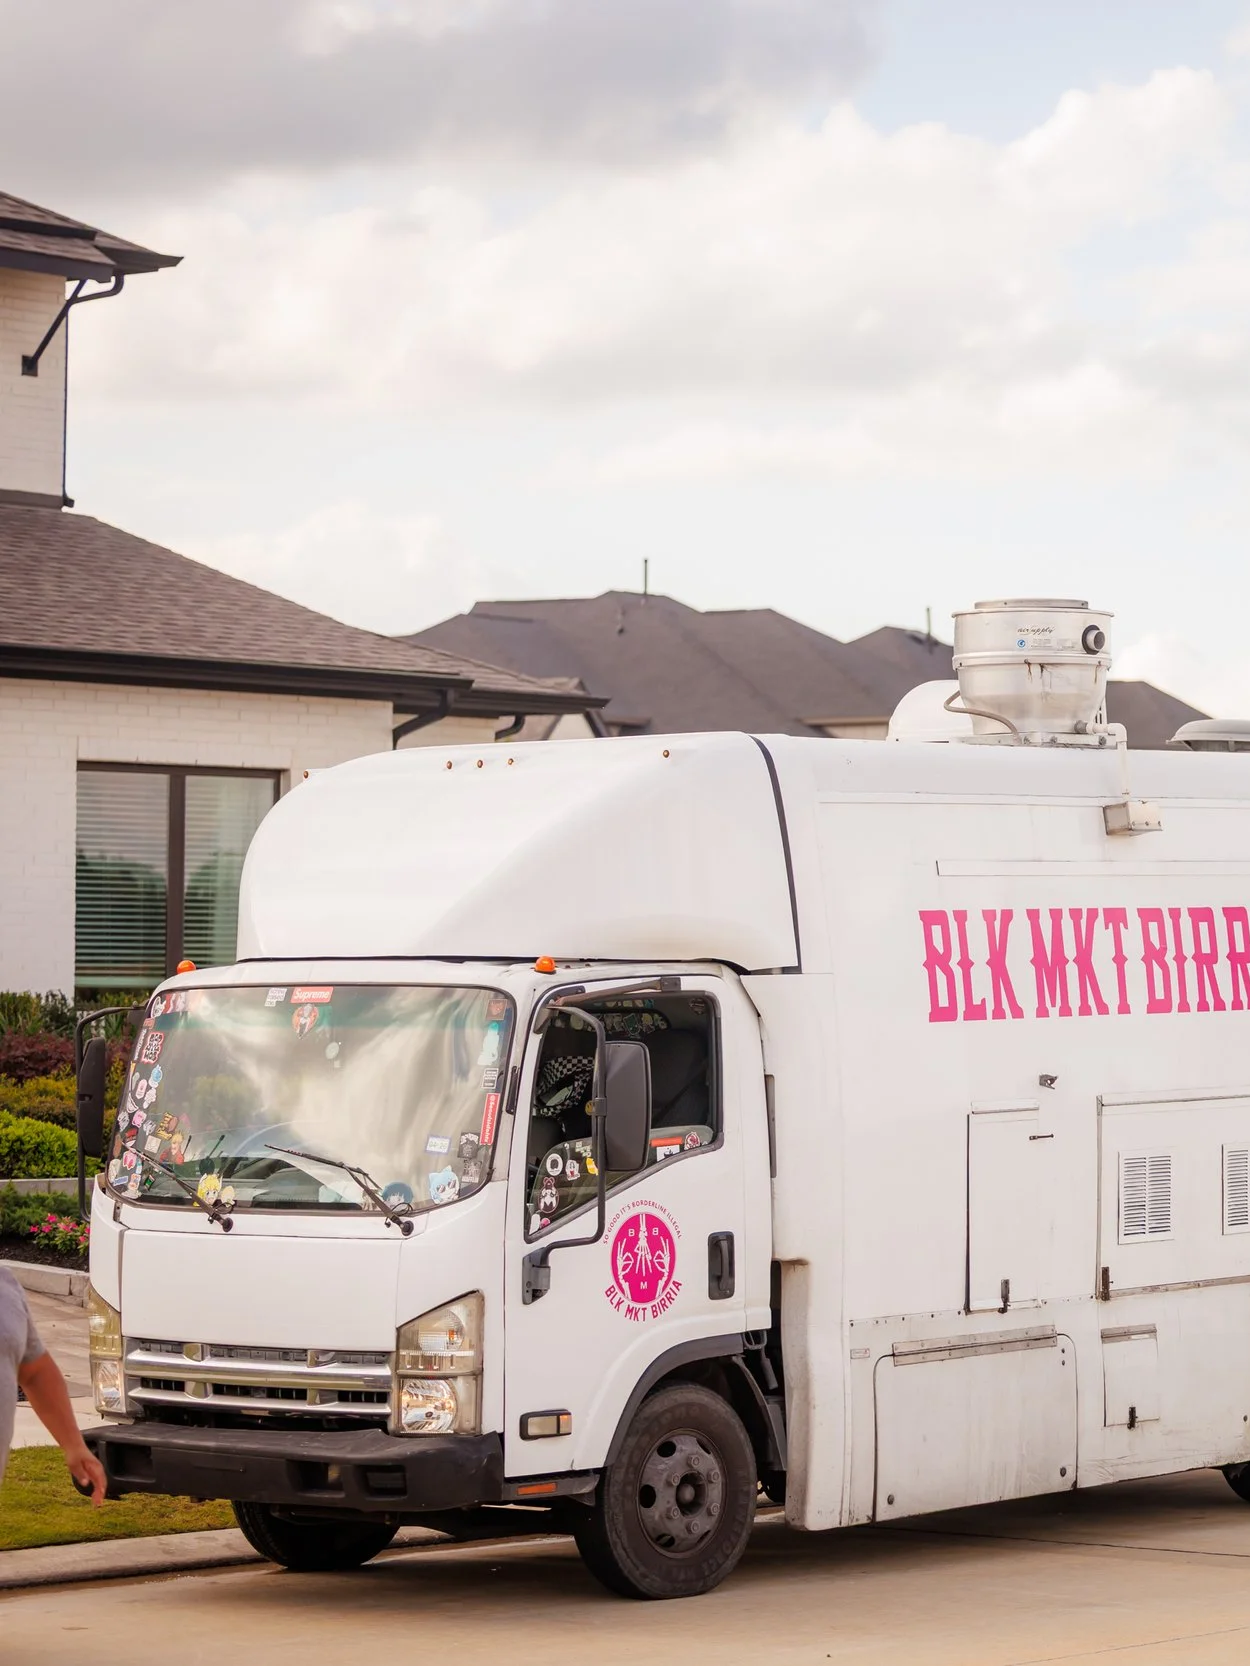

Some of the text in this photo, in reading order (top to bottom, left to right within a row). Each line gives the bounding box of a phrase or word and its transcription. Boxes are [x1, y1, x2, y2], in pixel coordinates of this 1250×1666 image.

[918, 909, 1024, 1023] BLK
[1025, 907, 1131, 1018] MKT
[293, 989, 330, 1001] Supreme
[603, 1199, 682, 1244] SO GOOD IT'S BORDERLINE ILLEGAL
[605, 1279, 682, 1321] BLK MKT BIRRIA
[640, 1281, 647, 1289] M
